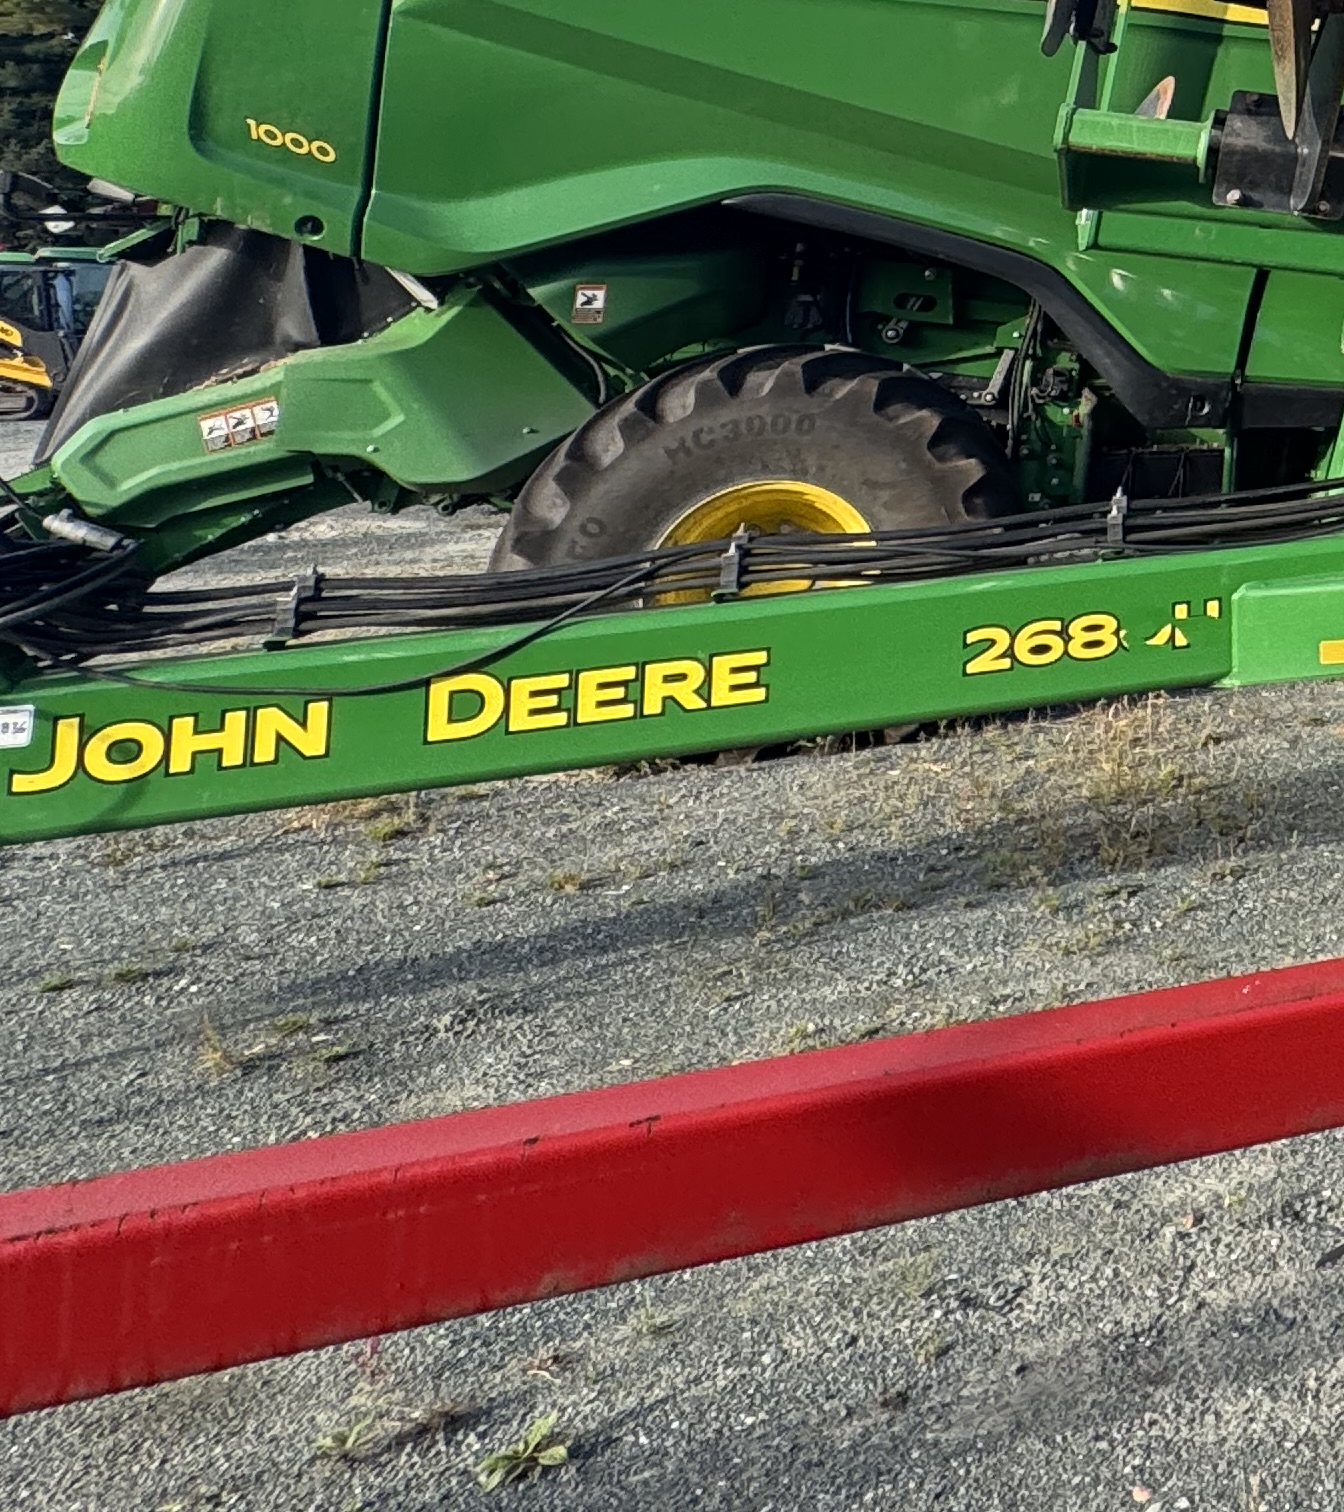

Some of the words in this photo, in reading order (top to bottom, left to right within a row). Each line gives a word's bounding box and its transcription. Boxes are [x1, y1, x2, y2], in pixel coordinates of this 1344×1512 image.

[245, 117, 337, 163] 1000
[8, 697, 332, 795] JOHN
[422, 647, 773, 746] DEERE
